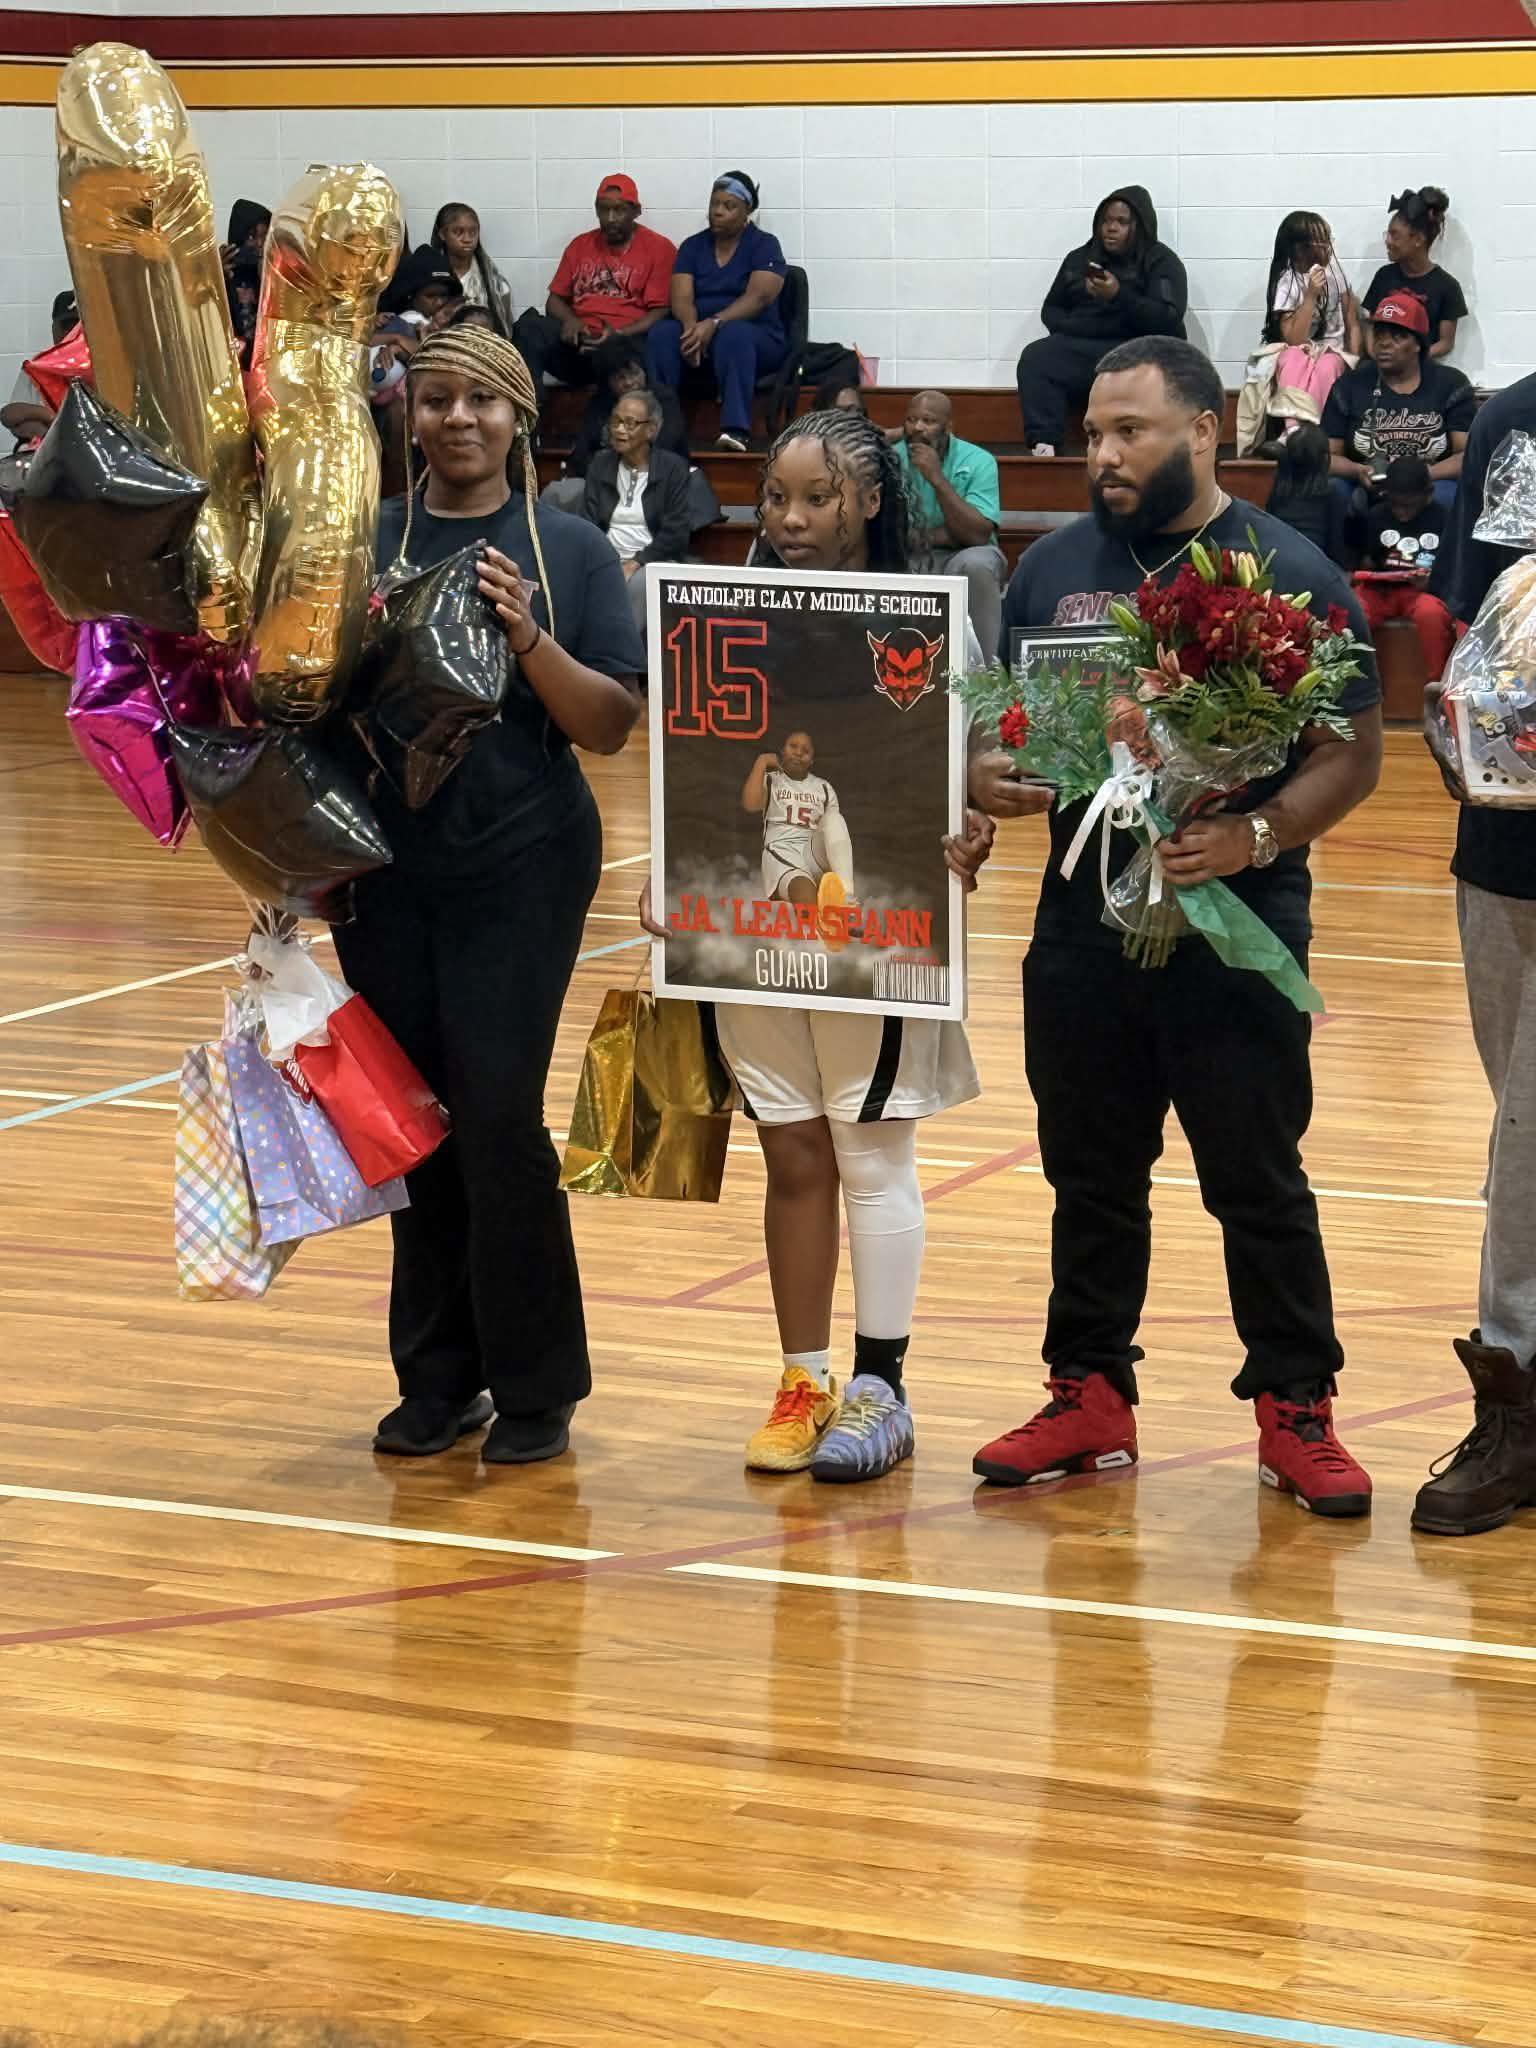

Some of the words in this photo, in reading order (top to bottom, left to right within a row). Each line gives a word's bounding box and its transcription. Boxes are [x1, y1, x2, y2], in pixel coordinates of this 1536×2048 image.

[667, 585, 756, 608] RANDOLPH
[760, 589, 806, 610] CLAY
[810, 591, 875, 613] MIDDLE
[880, 595, 942, 616] SCHOOL
[667, 616, 768, 739] 15
[786, 805, 811, 828] 15
[755, 948, 828, 990] GUARD
